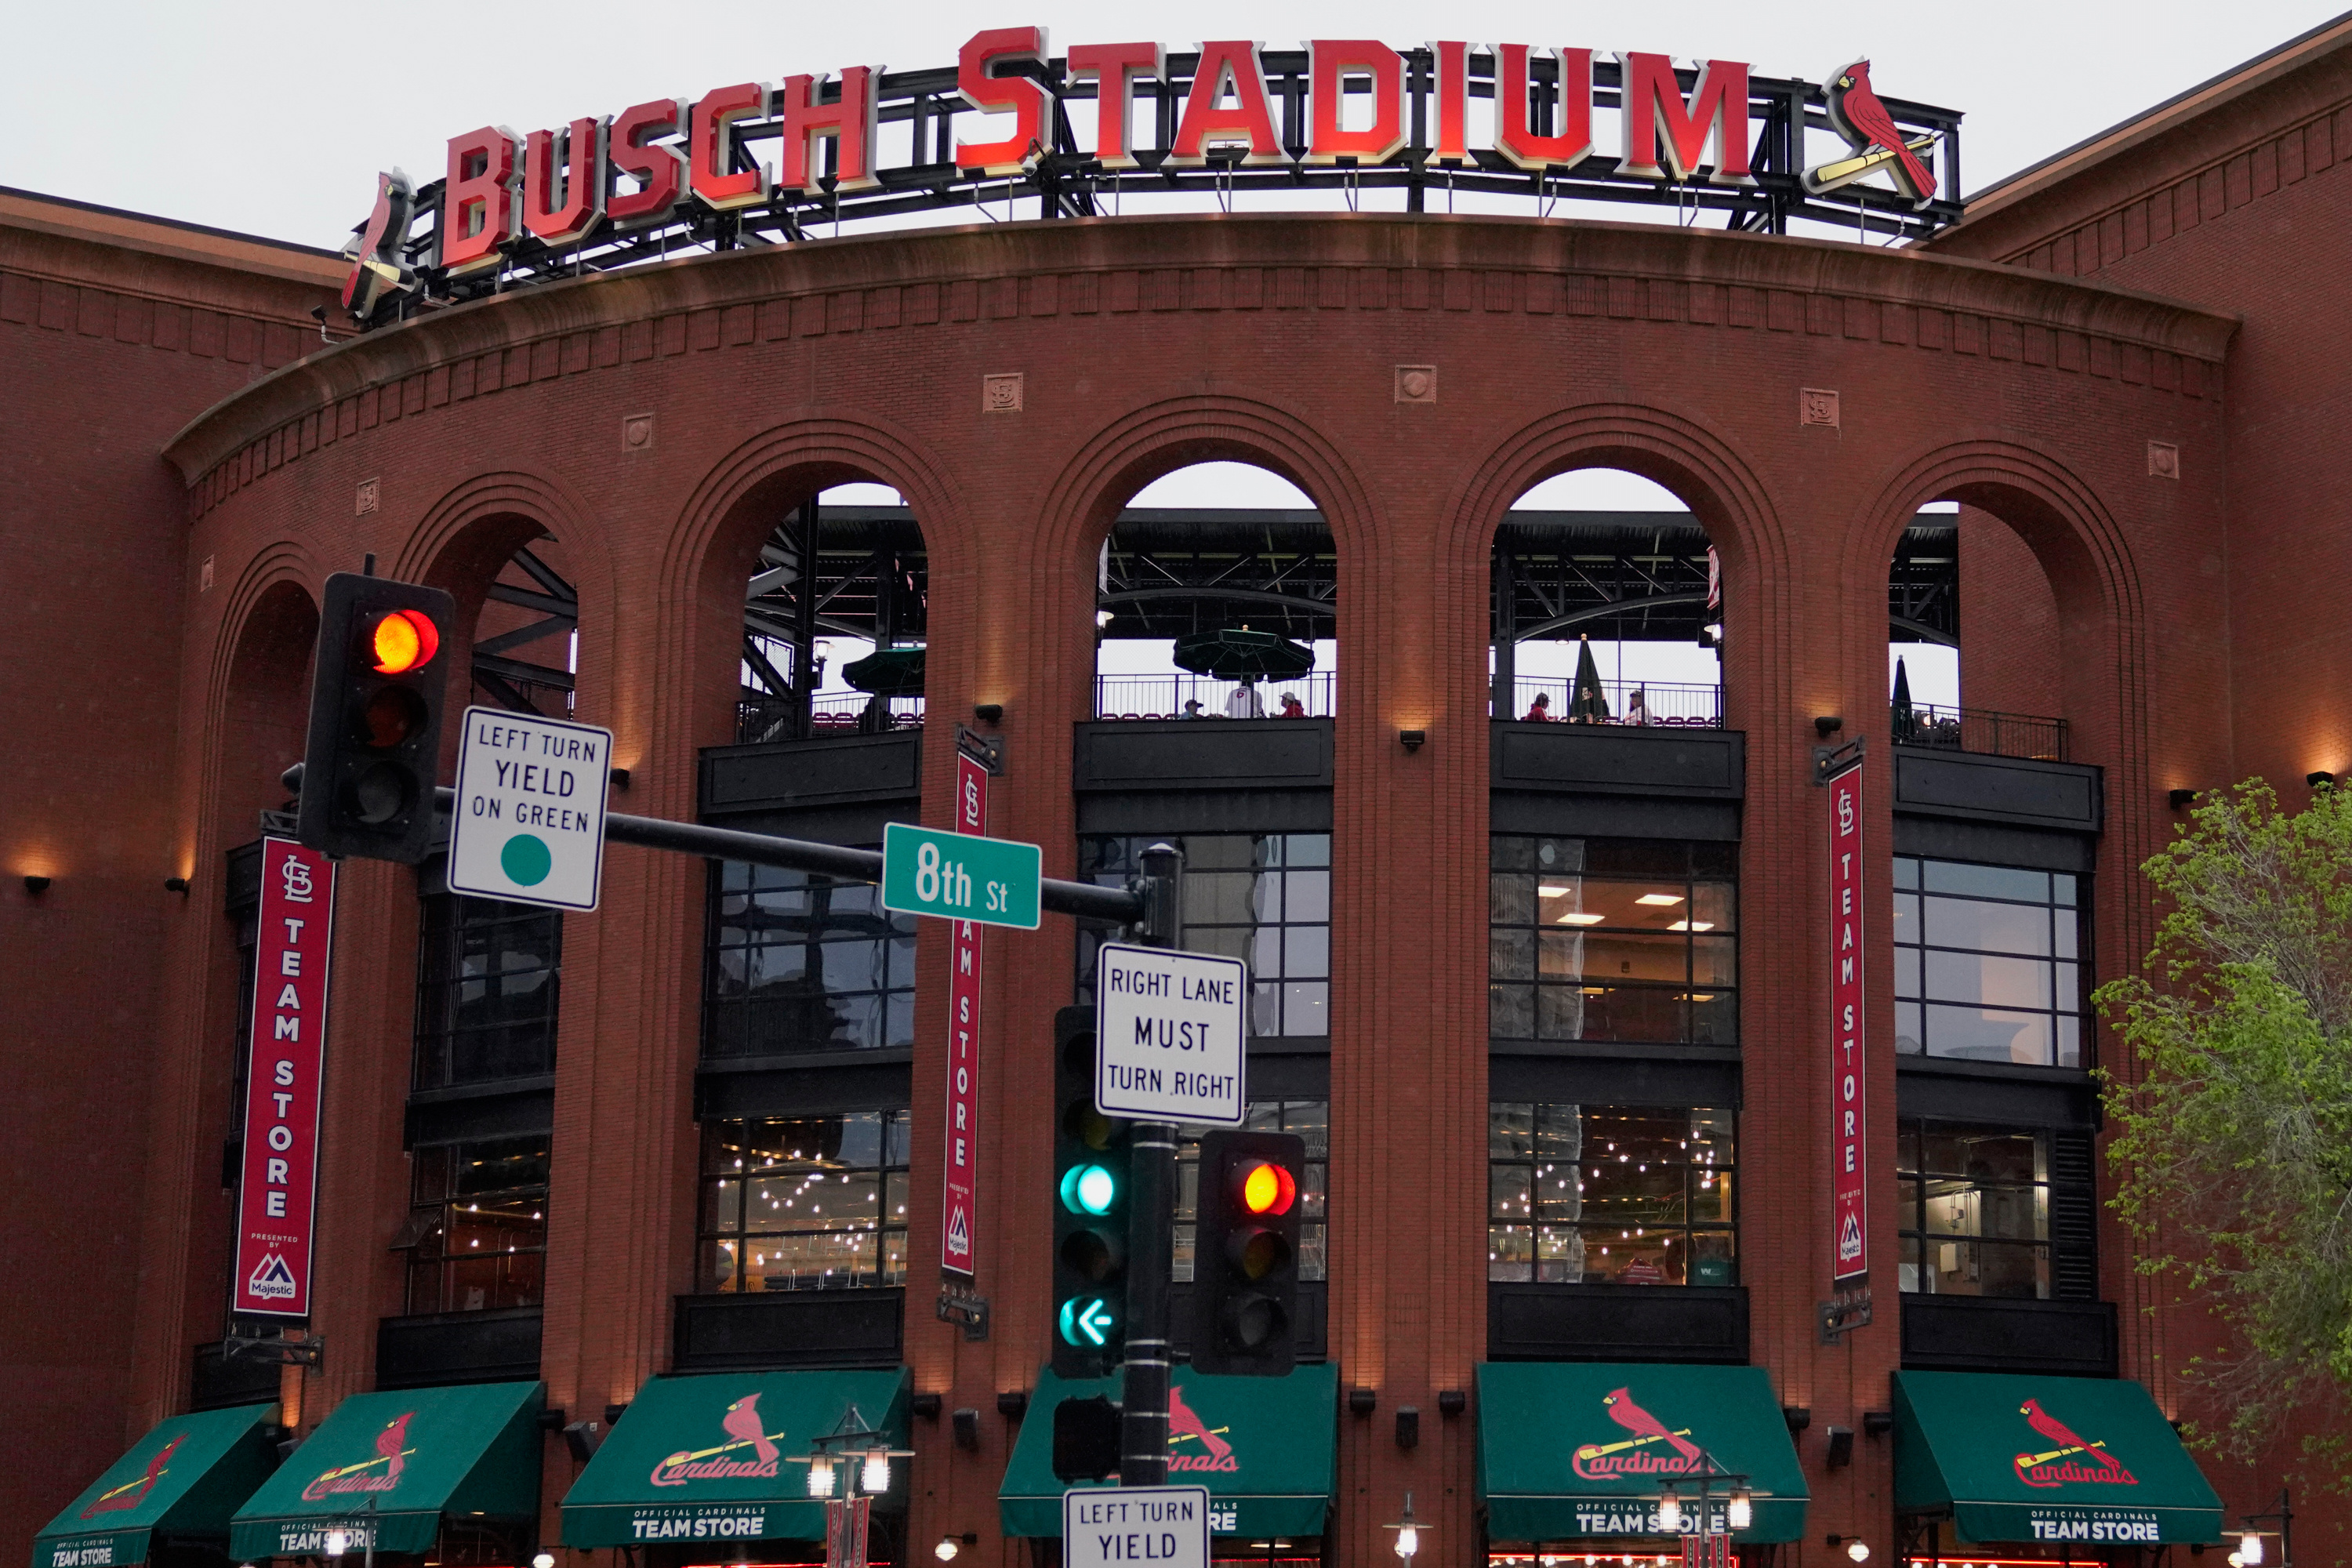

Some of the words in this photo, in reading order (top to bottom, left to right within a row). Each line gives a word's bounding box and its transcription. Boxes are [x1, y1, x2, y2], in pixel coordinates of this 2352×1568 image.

[442, 64, 887, 273] BUSCH
[956, 26, 1757, 185] STADIUM
[479, 724, 531, 751] LEFT
[543, 735, 596, 763] TURN
[495, 760, 575, 797] YIELD
[473, 796, 501, 818] ON
[516, 803, 588, 833] GREEN
[916, 842, 971, 907] 8th
[985, 880, 1008, 913] St
[1842, 852, 1853, 986] TEAM
[274, 917, 304, 1043] TEAM
[1111, 968, 1171, 997] RIGHT
[1183, 977, 1234, 1004] LANE
[1135, 1016, 1209, 1051] MUST
[956, 995, 970, 1167] STORE
[1108, 1065, 1162, 1093] TURN
[1175, 1072, 1233, 1099] RIGHT
[1843, 1004, 1855, 1173] STORE
[267, 1059, 294, 1218] STORE
[251, 1232, 298, 1243] PRESENTED
[252, 1282, 292, 1296] Majestic
[302, 1468, 399, 1501] Cardinals
[650, 1450, 779, 1486] Cardinals
[2013, 1453, 2140, 1487] Cardinals
[634, 1508, 691, 1519] OFFICIAL
[698, 1507, 766, 1517] CARDINALS
[1080, 1503, 1129, 1524] LEFT
[1140, 1501, 1193, 1522] TURN
[1576, 1513, 1643, 1533] TEAM
[1577, 1503, 1642, 1512] OFFICIAL
[2031, 1510, 2087, 1519] OFFICIAL
[2093, 1512, 2157, 1521] CARDINALS
[279, 1532, 322, 1552] TEAM
[632, 1519, 691, 1539] TEAM
[693, 1516, 764, 1537] STORE
[2031, 1520, 2089, 1539] TEAM
[2092, 1522, 2160, 1541] STORE
[52, 1550, 79, 1567] TEAM
[81, 1548, 113, 1565] STORE
[1098, 1534, 1176, 1561] YIELD
